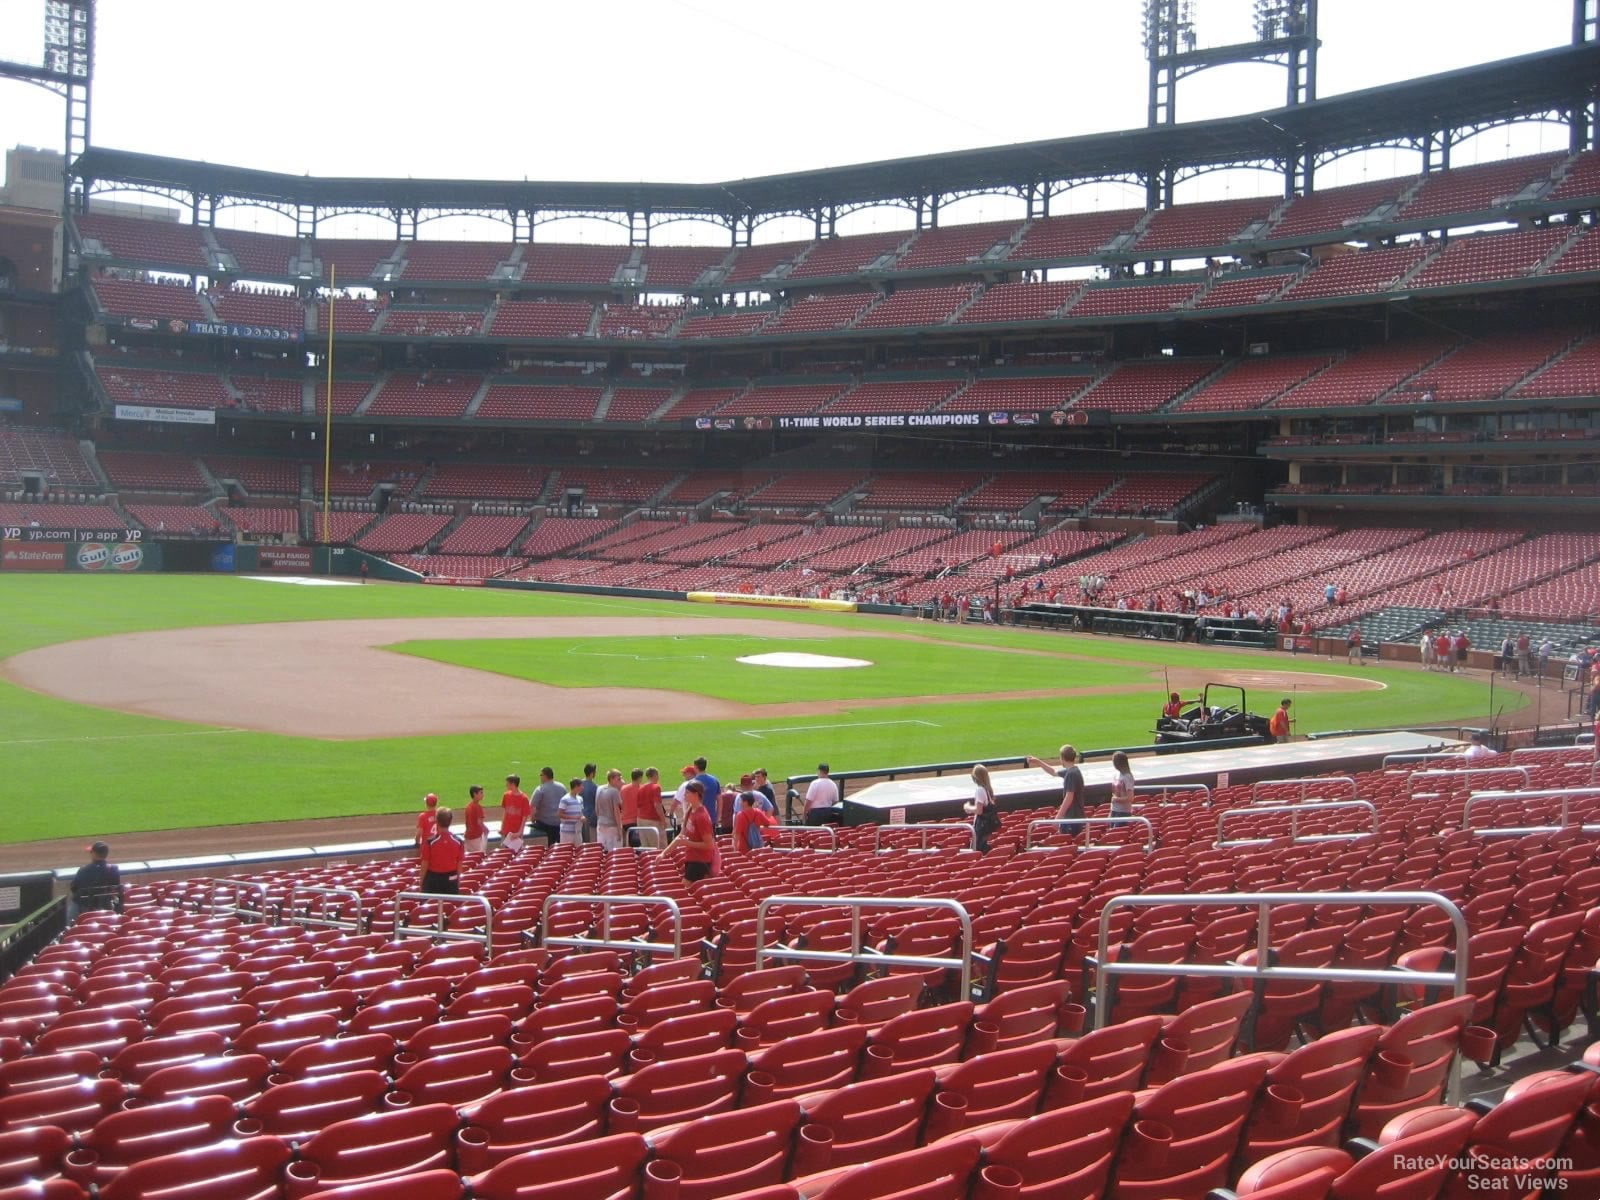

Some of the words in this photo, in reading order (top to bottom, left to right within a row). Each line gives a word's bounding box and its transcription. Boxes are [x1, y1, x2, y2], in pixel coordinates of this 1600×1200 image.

[195, 323, 228, 335] THAT'S
[233, 326, 240, 336] A
[780, 417, 820, 428] 11-TIME
[823, 417, 862, 427] WORLD
[865, 416, 905, 426] SERIES
[908, 414, 980, 426] CHAMPIONS
[4, 527, 21, 538] yp
[30, 530, 71, 540] yp.com
[80, 531, 93, 541] yp
[97, 531, 118, 541] app
[126, 530, 141, 540] yp
[80, 550, 107, 563] Gulf
[113, 550, 140, 563] Gulf
[261, 551, 285, 559] WELLS
